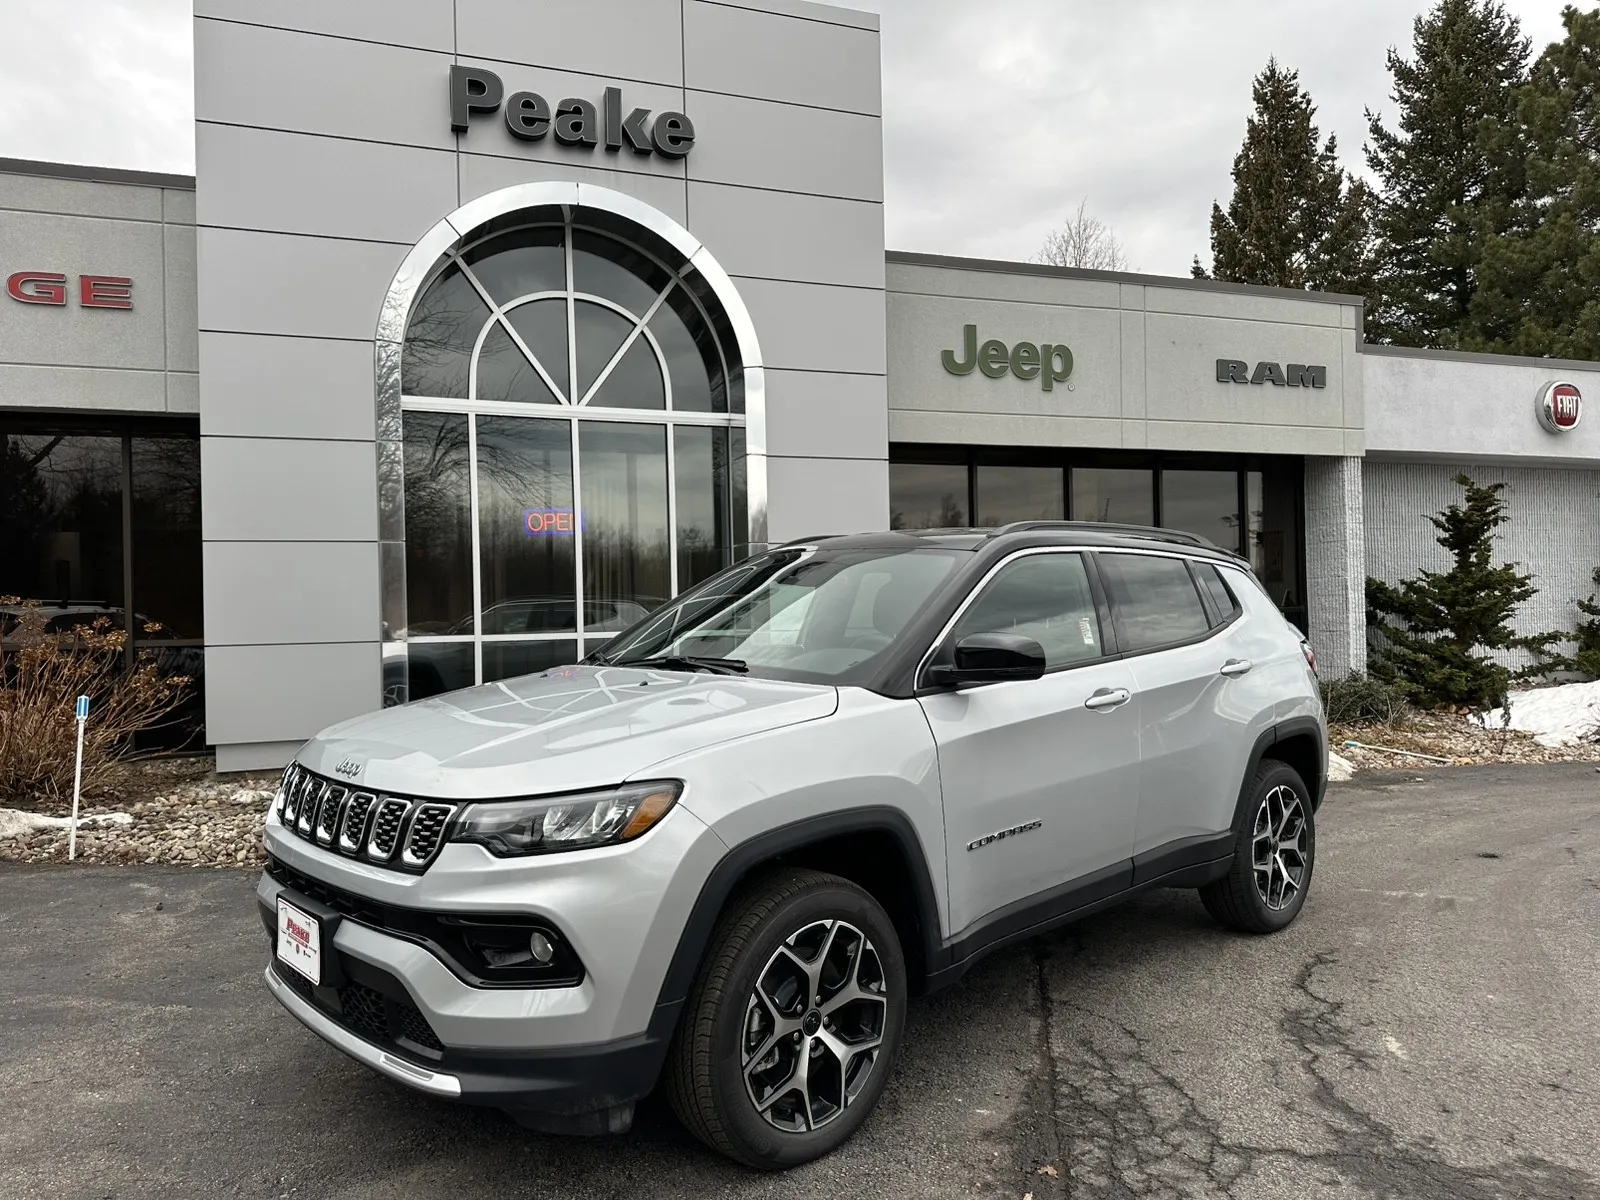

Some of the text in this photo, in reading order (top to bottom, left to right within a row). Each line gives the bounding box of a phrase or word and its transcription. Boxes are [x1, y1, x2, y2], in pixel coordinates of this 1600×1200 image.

[449, 64, 696, 160] Peake
[6, 271, 133, 311] GE
[941, 324, 1074, 391] Jeep
[1216, 358, 1327, 388] RAM
[1556, 394, 1579, 418] FIAT
[335, 756, 364, 780] Jeep
[966, 818, 1043, 852] COMPASS
